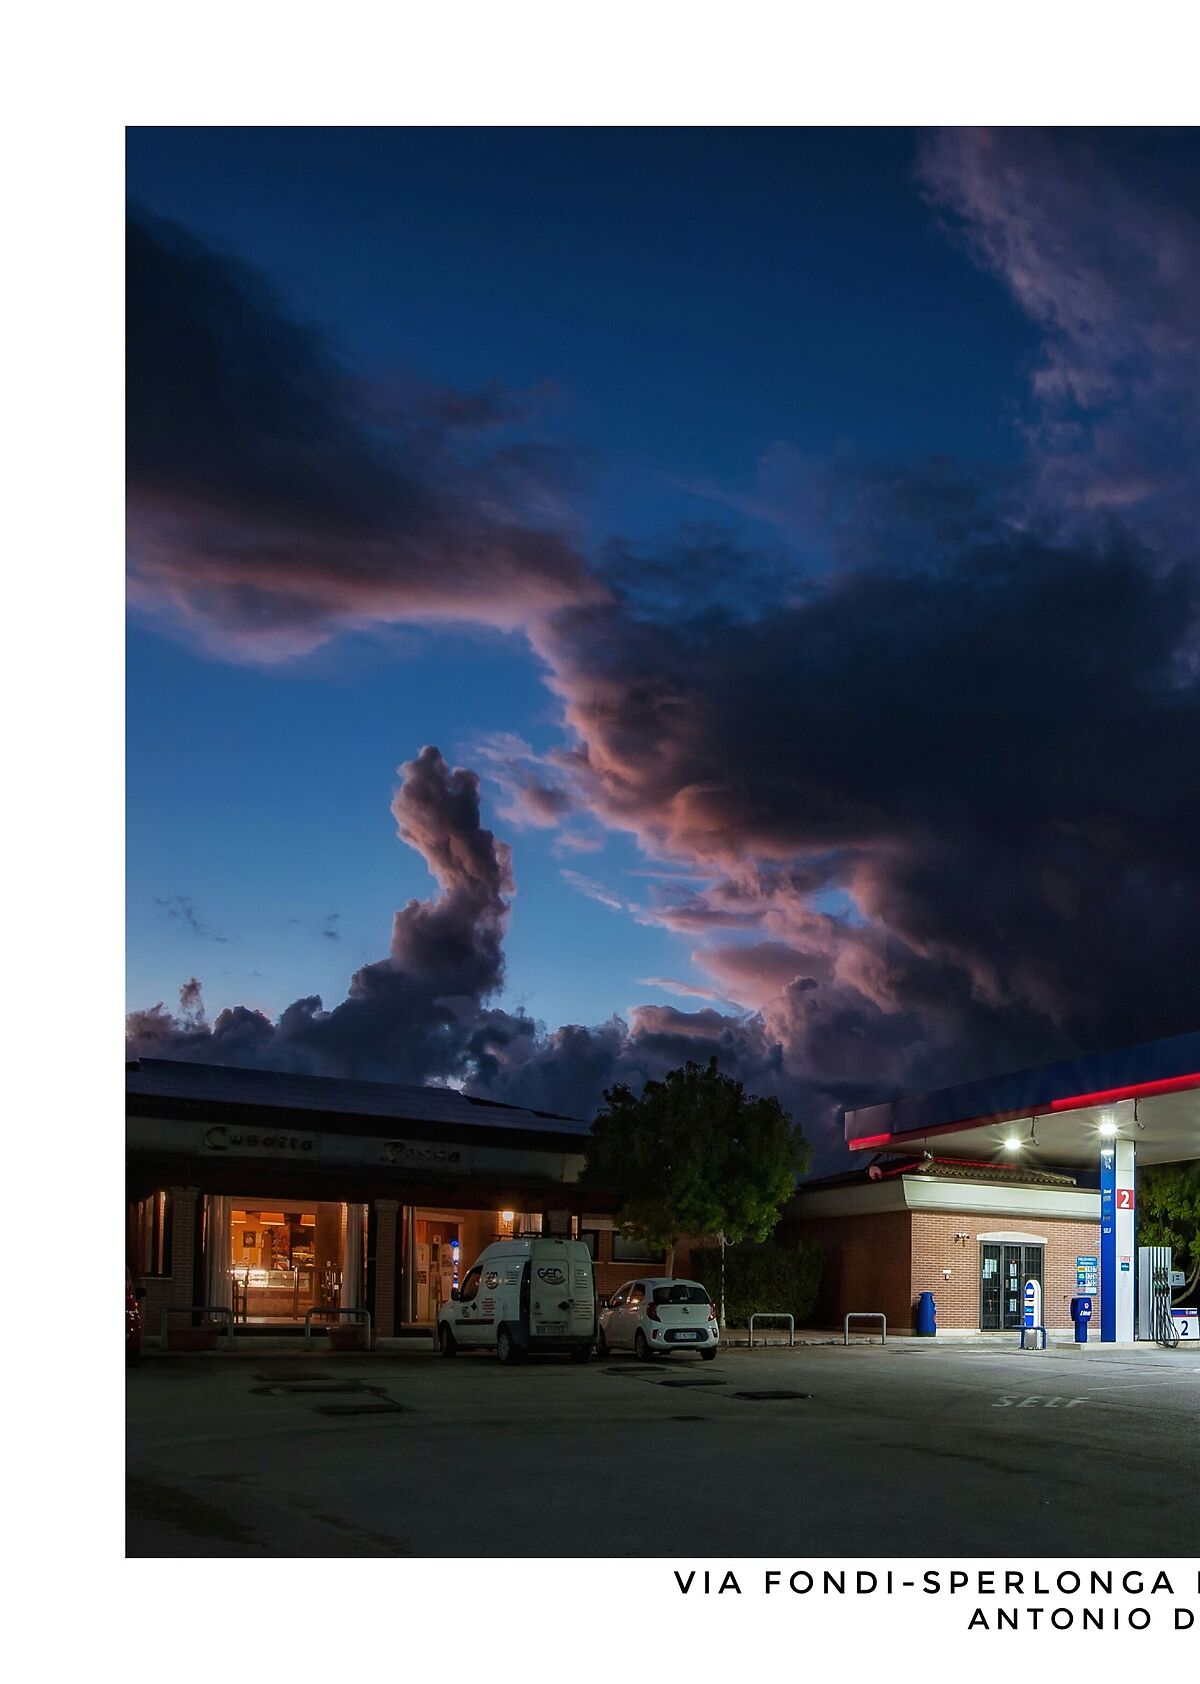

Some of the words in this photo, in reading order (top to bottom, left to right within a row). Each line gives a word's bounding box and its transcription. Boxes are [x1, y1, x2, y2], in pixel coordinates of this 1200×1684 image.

[1120, 1190, 1130, 1208] 2
[1180, 1320, 1189, 1336] 2
[991, 1395, 1090, 1408] SELF
